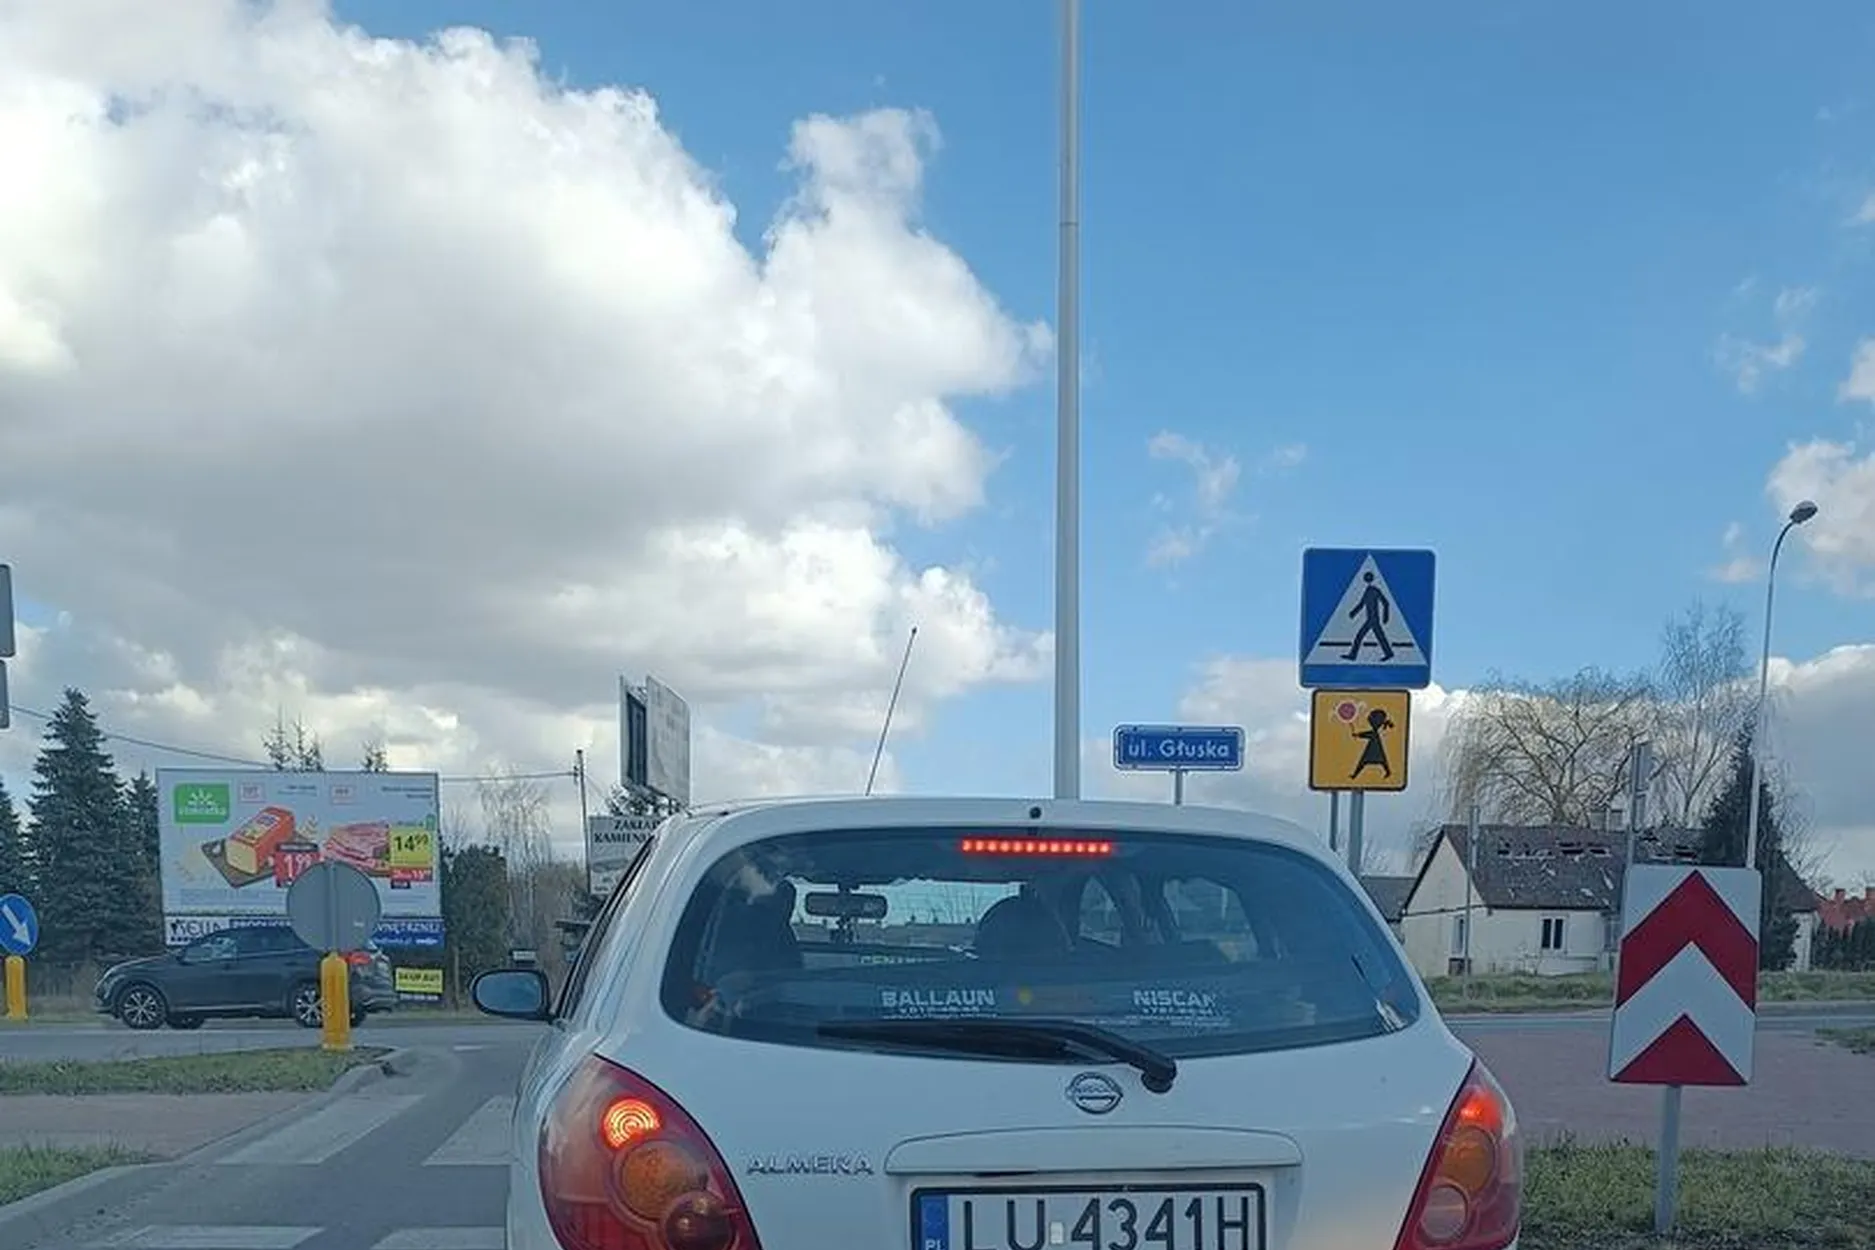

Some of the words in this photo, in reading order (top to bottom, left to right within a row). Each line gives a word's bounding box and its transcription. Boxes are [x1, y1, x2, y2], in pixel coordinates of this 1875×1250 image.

[1128, 739, 1152, 757] ul.
[1160, 739, 1229, 757] Głuska
[881, 989, 996, 1007] BALLAUN
[746, 1156, 874, 1174] ALMERA
